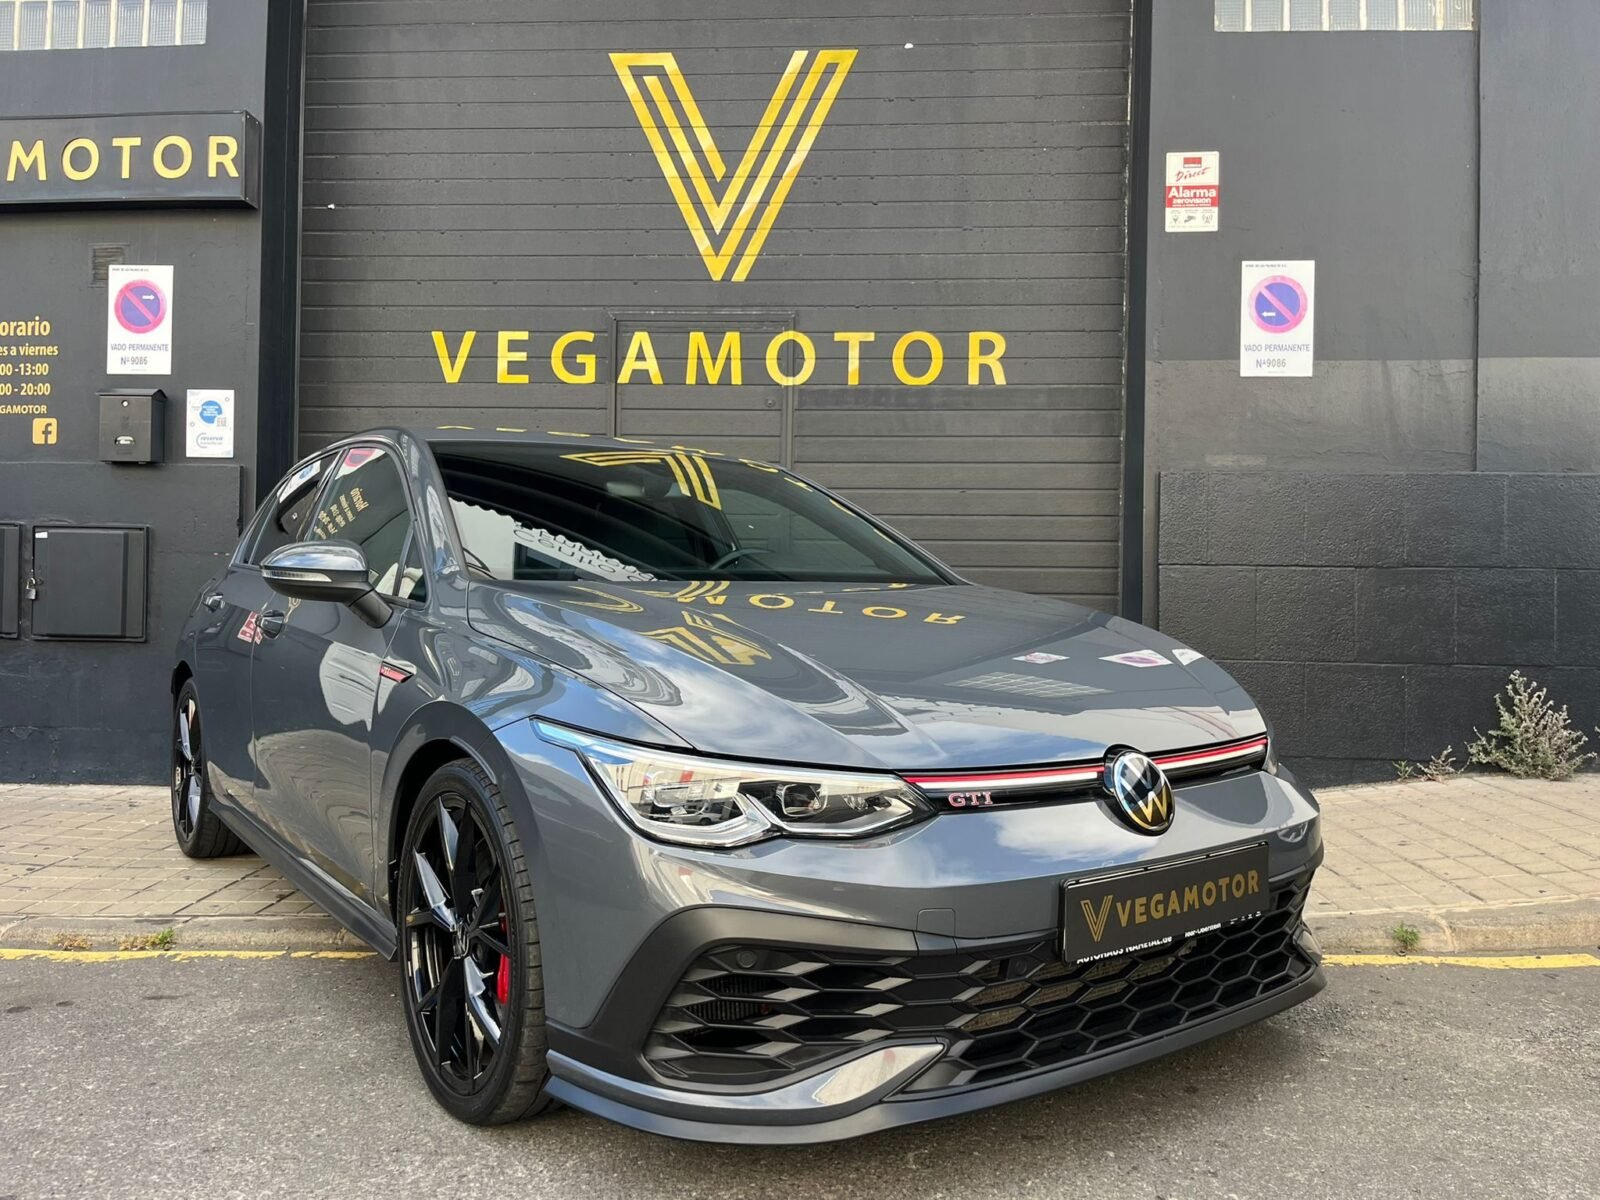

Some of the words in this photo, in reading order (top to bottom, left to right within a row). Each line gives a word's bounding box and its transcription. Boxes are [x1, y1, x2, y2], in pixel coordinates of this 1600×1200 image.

[6, 135, 240, 182] MOTOR
[1167, 187, 1217, 198] Alarma
[0, 316, 51, 336] orario
[10, 346, 17, 356] a
[19, 343, 59, 356] viernes
[111, 343, 127, 352] VADO
[128, 343, 169, 352] PERMANENTE
[1243, 343, 1263, 352] VADO
[1264, 343, 1311, 352] PERMANENTE
[431, 330, 1008, 386] VEGAMOTOR
[20, 383, 51, 396] 20:00
[0, 404, 48, 414] GAMOTOR
[948, 791, 994, 807] GTI
[1116, 869, 1260, 928] VEGAMOTOR
